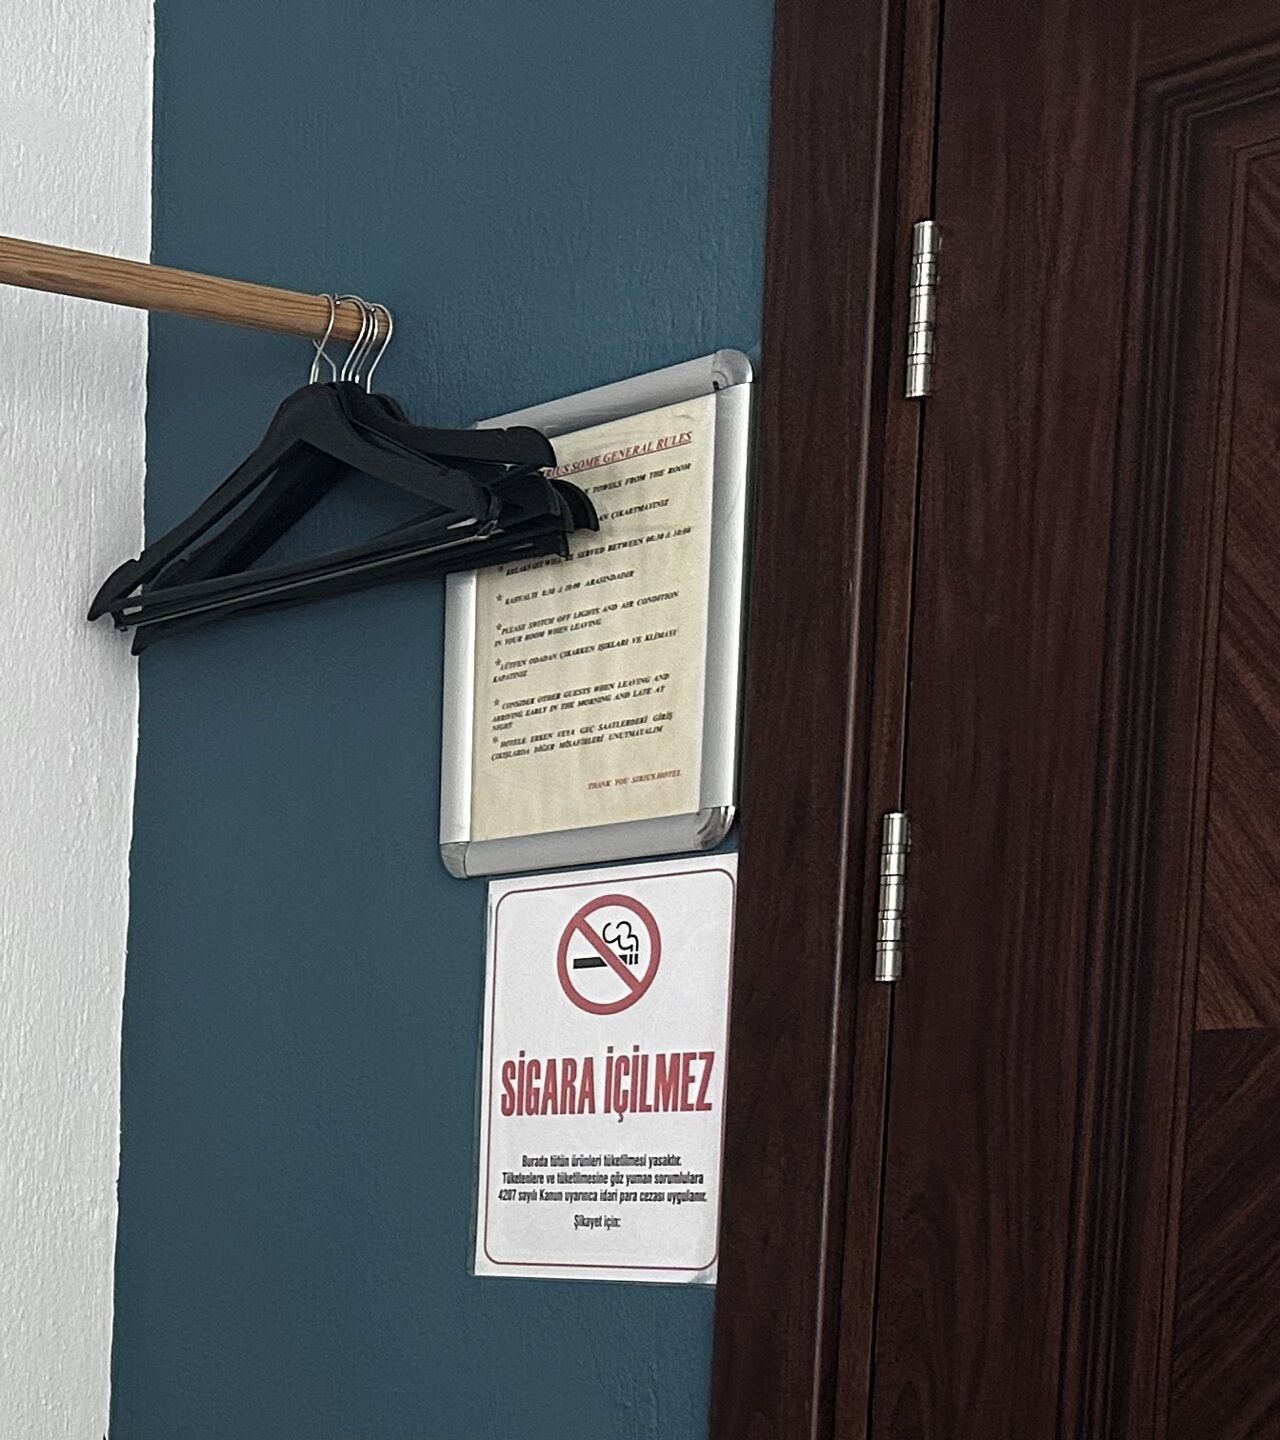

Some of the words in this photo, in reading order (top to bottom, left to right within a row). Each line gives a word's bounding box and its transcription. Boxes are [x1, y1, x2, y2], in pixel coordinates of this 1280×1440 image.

[571, 455, 601, 470] SOME
[603, 441, 653, 464] GENERAL
[656, 431, 693, 449] RULES
[625, 474, 646, 485] FROM
[649, 469, 665, 479] THE
[668, 463, 691, 474] ROOM
[577, 547, 605, 559] SERVED
[608, 537, 645, 551] BETWEEN
[528, 617, 555, 629] SWITCH
[557, 613, 572, 623] OFF
[573, 607, 600, 620] LIGHTS
[602, 604, 618, 613] AND
[621, 600, 635, 609] AIR
[637, 591, 679, 606] CONDITION
[494, 640, 502, 648] IN
[505, 635, 523, 645] YOUR
[525, 631, 545, 641] ROOM
[547, 626, 569, 636] WHEN
[570, 618, 602, 631] LEAVING
[529, 653, 558, 665] ODADAN
[632, 636, 642, 644] VE
[502, 697, 535, 710] CONSIDER
[537, 692, 561, 703] OTHER
[563, 687, 591, 698] GUESTS
[594, 682, 616, 692] WHEN
[617, 676, 652, 688] LEAVING
[654, 672, 670, 682] AND
[492, 710, 524, 722] ARRIVING
[525, 706, 548, 716] EARLY
[549, 704, 559, 712] IN
[561, 701, 575, 710] THE
[577, 694, 612, 707] MORNING
[614, 692, 631, 700] AND
[632, 687, 652, 697] LATE
[655, 685, 666, 693] AT
[530, 732, 554, 743] ERKEN
[614, 777, 630, 786] YOU
[501, 1050, 596, 1116] SİGARA
[603, 1045, 715, 1123] İÇİLMEZ
[522, 1154, 548, 1167] Burada
[550, 1154, 569, 1167] tütün
[571, 1154, 602, 1167] ürünleri
[603, 1154, 647, 1166] tüketilmesi
[502, 1172, 544, 1184] Tüketenlere
[546, 1174, 555, 1184] ve
[557, 1172, 608, 1184] tüketilmesine
[610, 1171, 624, 1187] göz
[626, 1174, 652, 1187] yuman
[654, 1171, 704, 1184] sorumlulara
[498, 1189, 516, 1201] 4207
[518, 1188, 537, 1203] sayılı
[539, 1189, 563, 1201] Kanun
[600, 1188, 618, 1201] idari
[619, 1191, 638, 1204] para
[640, 1191, 665, 1201] cezası
[574, 1214, 602, 1230] Şikayet
